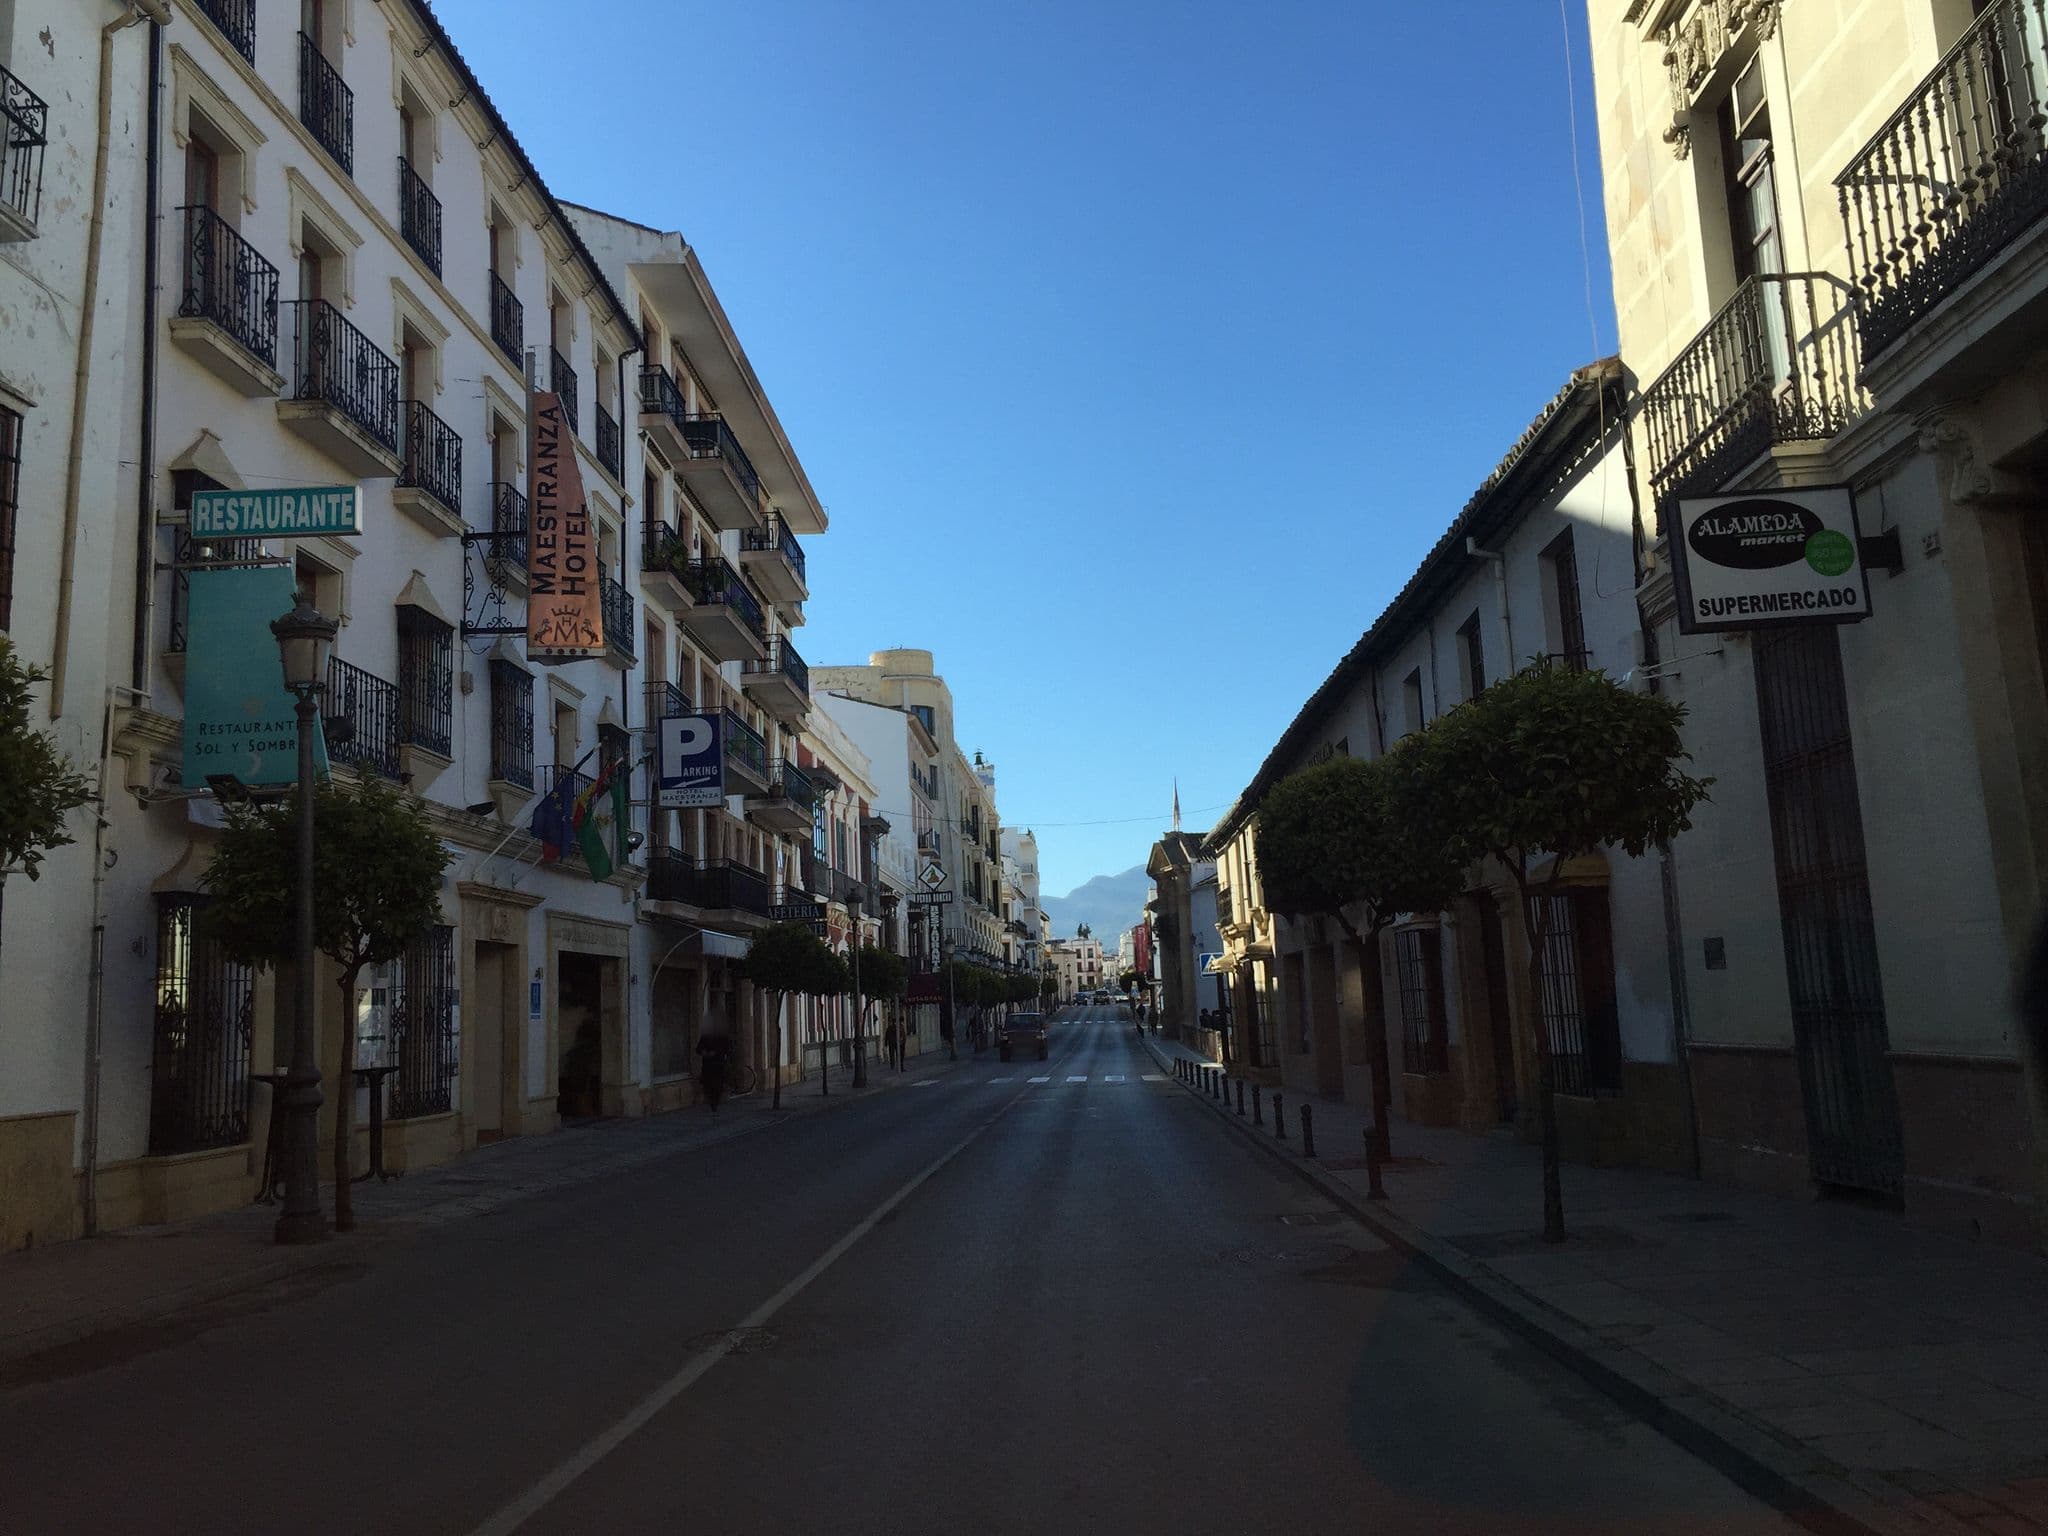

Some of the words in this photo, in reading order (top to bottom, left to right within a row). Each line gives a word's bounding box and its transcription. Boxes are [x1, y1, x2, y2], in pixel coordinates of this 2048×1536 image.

[197, 493, 354, 531] RESTAURANTE
[532, 405, 560, 596] MAESTRANZA
[1698, 512, 1804, 536] ALAMEDA
[561, 503, 587, 596] HOTEL
[1740, 533, 1806, 547] market
[1699, 588, 1857, 617] SUPERMERCADO
[199, 720, 300, 736] RESTAURANT
[194, 742, 221, 755] SOL
[232, 742, 239, 753] Y
